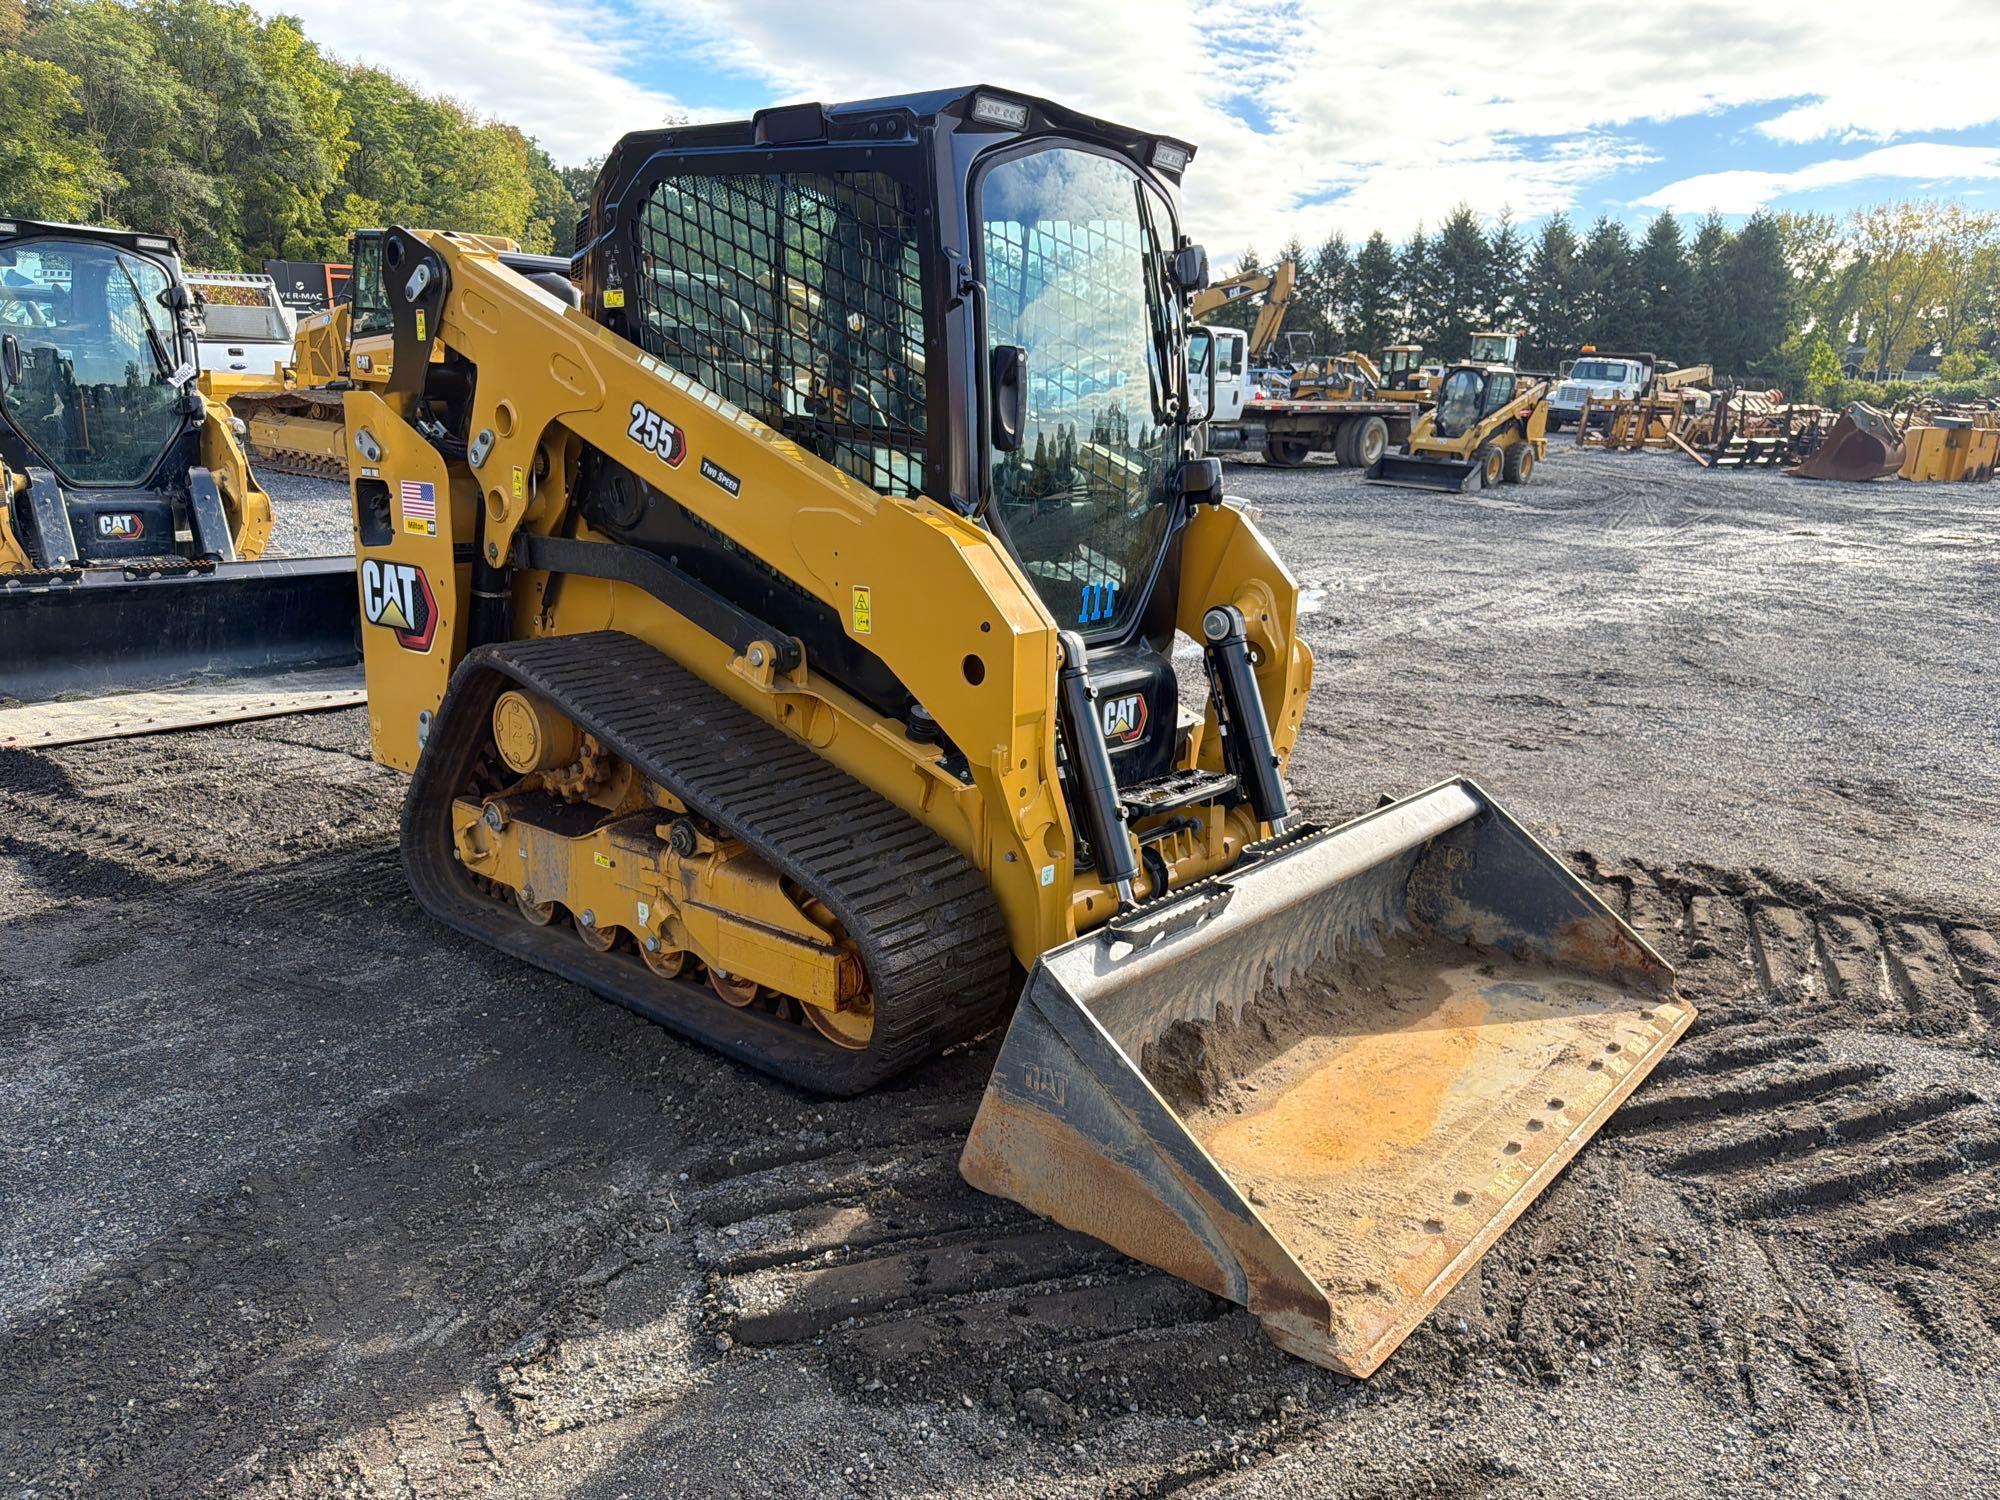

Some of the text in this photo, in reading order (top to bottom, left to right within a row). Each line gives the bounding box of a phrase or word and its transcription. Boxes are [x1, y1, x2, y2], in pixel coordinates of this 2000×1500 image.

[356, 354, 369, 369] CAT
[628, 402, 675, 459] 255
[100, 515, 132, 535] CAT
[407, 520, 425, 531] Milton
[362, 559, 416, 631] CAT
[1078, 581, 1114, 624] 111
[1103, 696, 1138, 736] CAT
